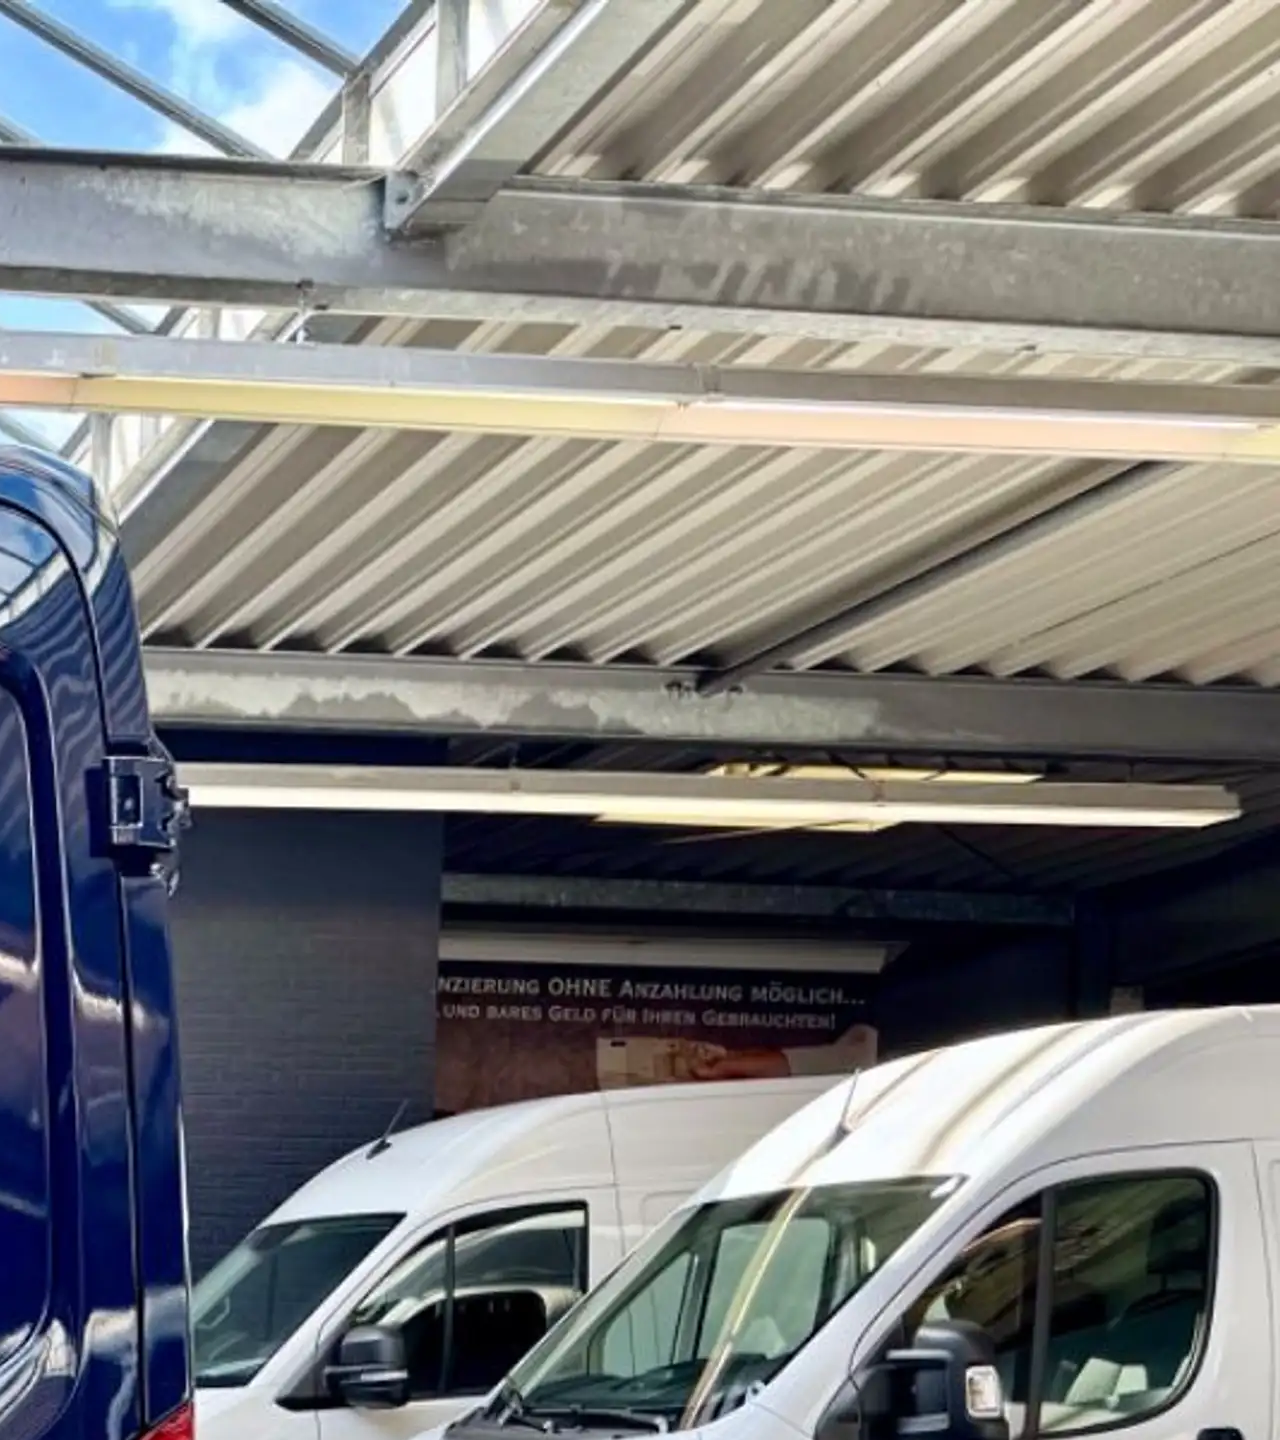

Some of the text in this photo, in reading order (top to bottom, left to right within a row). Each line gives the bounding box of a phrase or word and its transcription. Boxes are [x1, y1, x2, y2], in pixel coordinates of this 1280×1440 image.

[548, 976, 612, 997] OHNE
[619, 979, 743, 1002] ANZAHLUNG
[443, 1004, 480, 1018] UND
[486, 1005, 541, 1020] BARES
[548, 1005, 596, 1022] GELD
[601, 1005, 636, 1024] FÜR
[642, 1008, 696, 1025] IHREN
